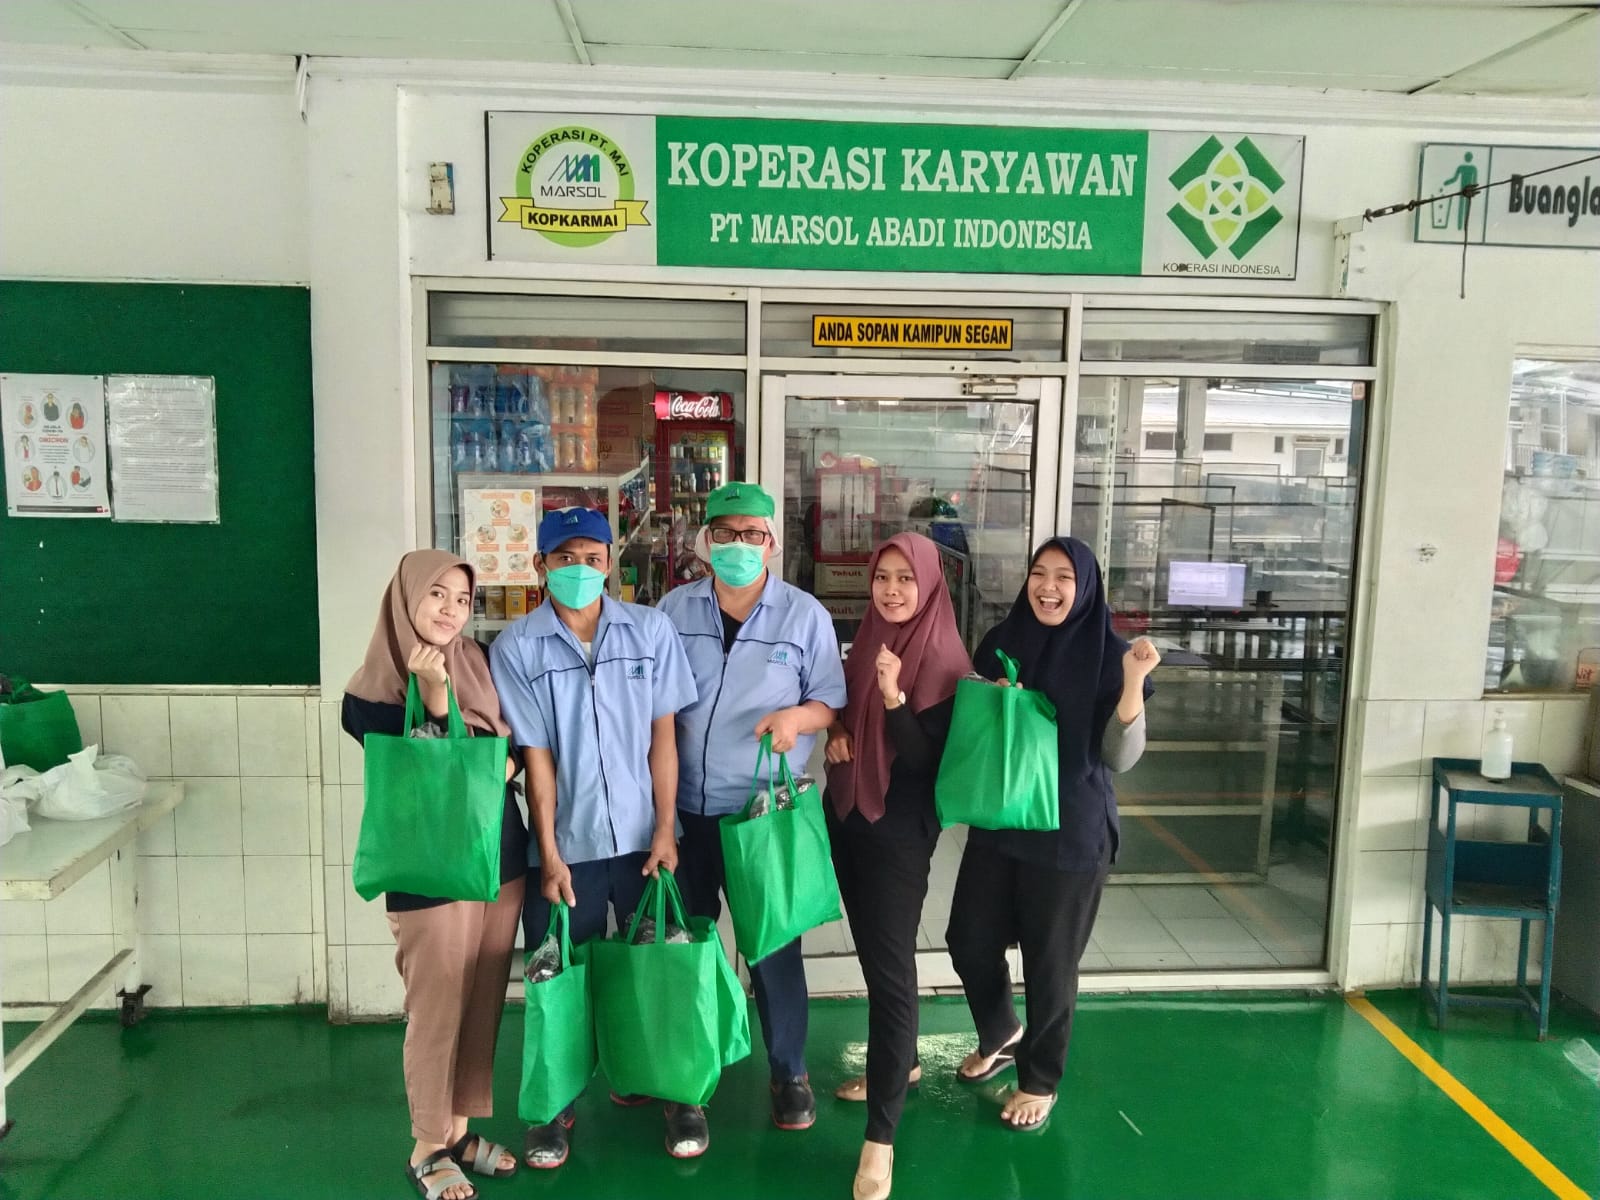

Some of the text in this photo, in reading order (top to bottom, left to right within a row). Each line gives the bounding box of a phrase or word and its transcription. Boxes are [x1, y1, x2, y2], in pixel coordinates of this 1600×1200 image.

[521, 129, 585, 174] KOPERASI
[609, 150, 629, 177] MAI
[667, 141, 1138, 196] KOPERASI KARYAWAN
[540, 185, 607, 198] MARSOL
[527, 212, 618, 227] KOPKARMAI
[710, 212, 1093, 250] PT MARSOL ABADI INDONESIA
[1162, 262, 1281, 275] KOERASI INDONESIA
[818, 321, 1008, 345] ANDA SOPAN KAMIPUN SEGAN
[671, 395, 720, 419] Coca-Cola
